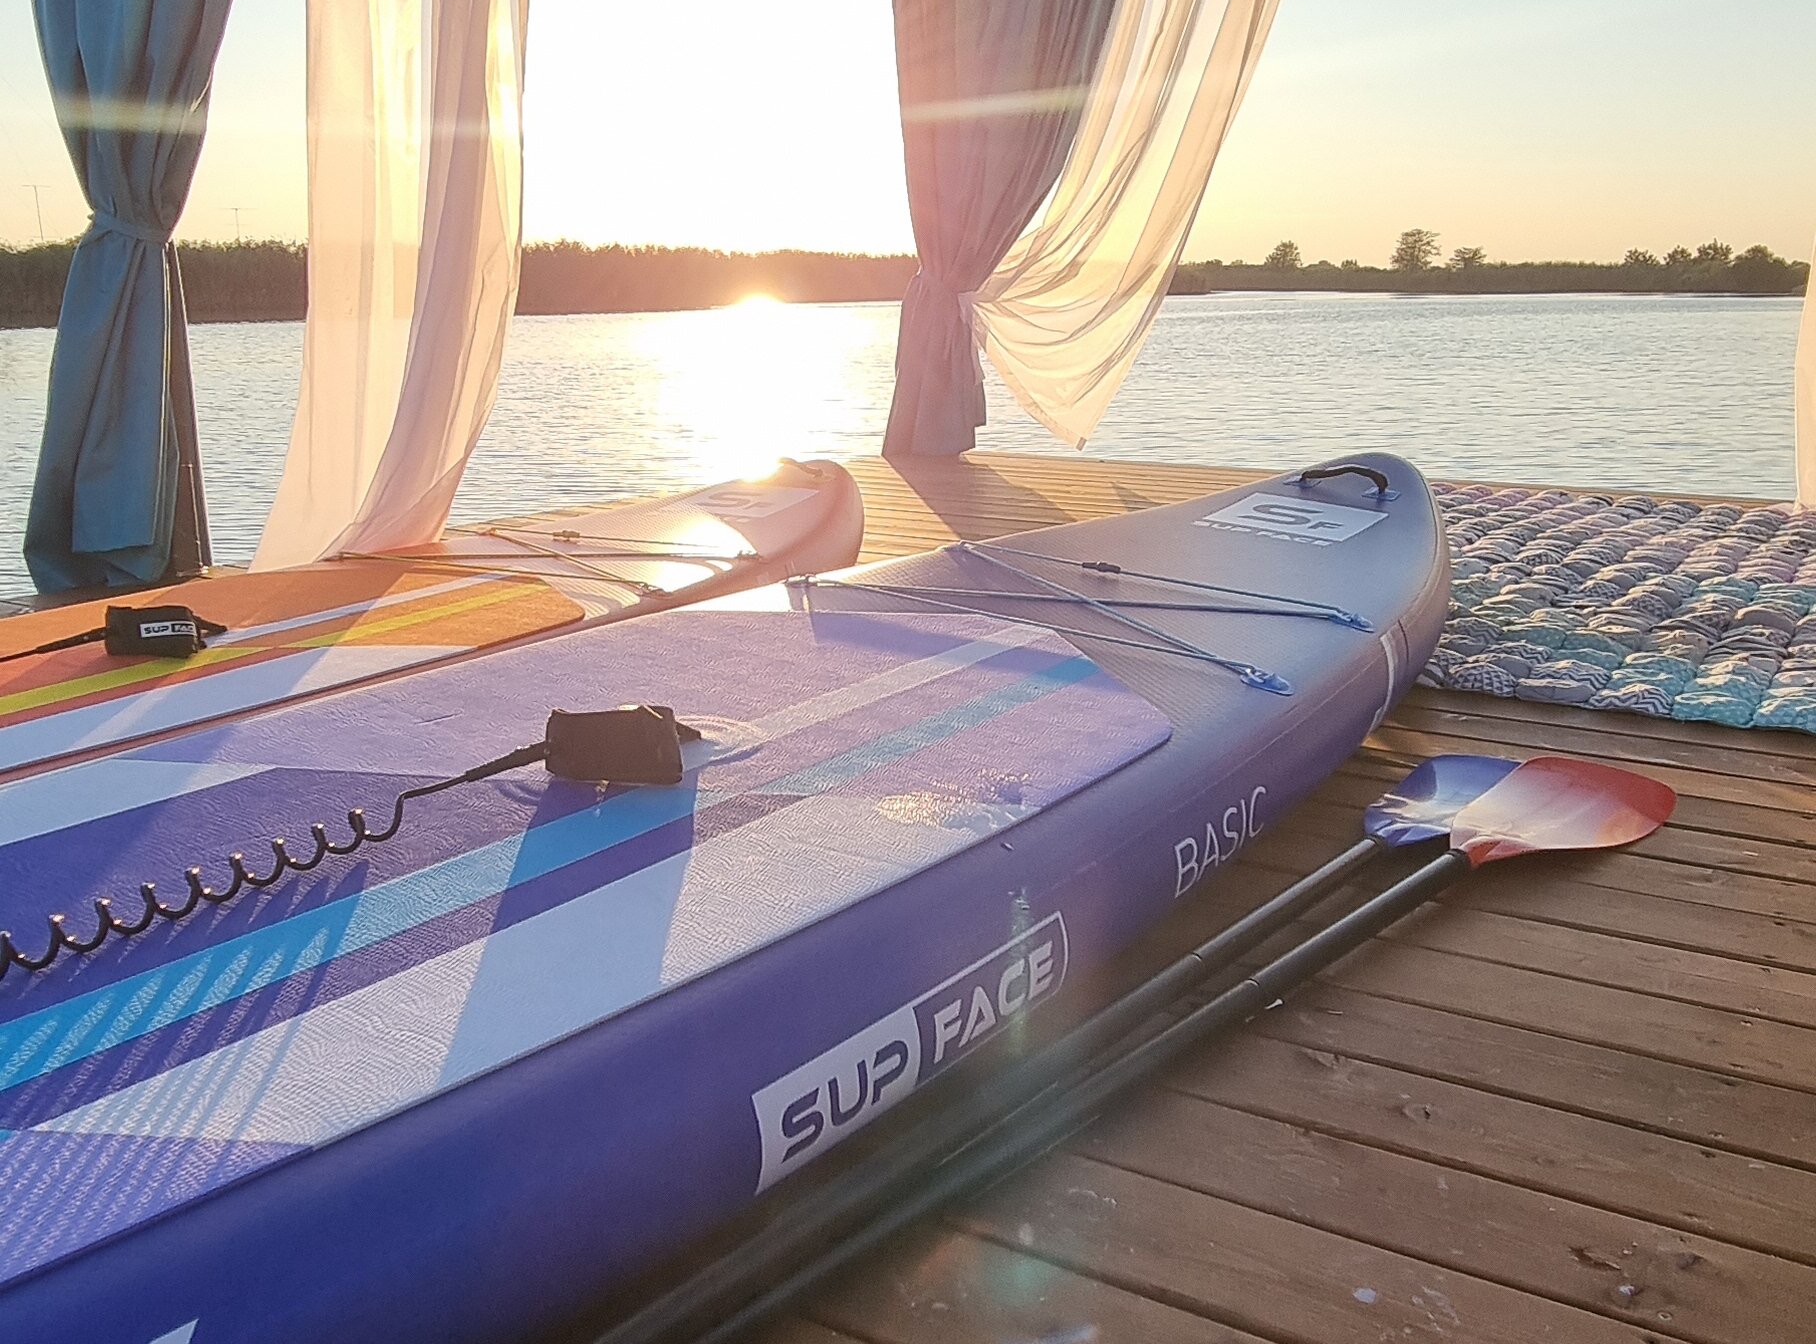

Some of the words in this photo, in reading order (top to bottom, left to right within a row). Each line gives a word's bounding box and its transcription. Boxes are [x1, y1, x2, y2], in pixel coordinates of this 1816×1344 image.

[1236, 504, 1344, 530] SF
[143, 625, 170, 635] SUP
[1174, 785, 1267, 899] BASIC
[781, 1040, 910, 1164] SUP
[933, 940, 1055, 1065] FACE
